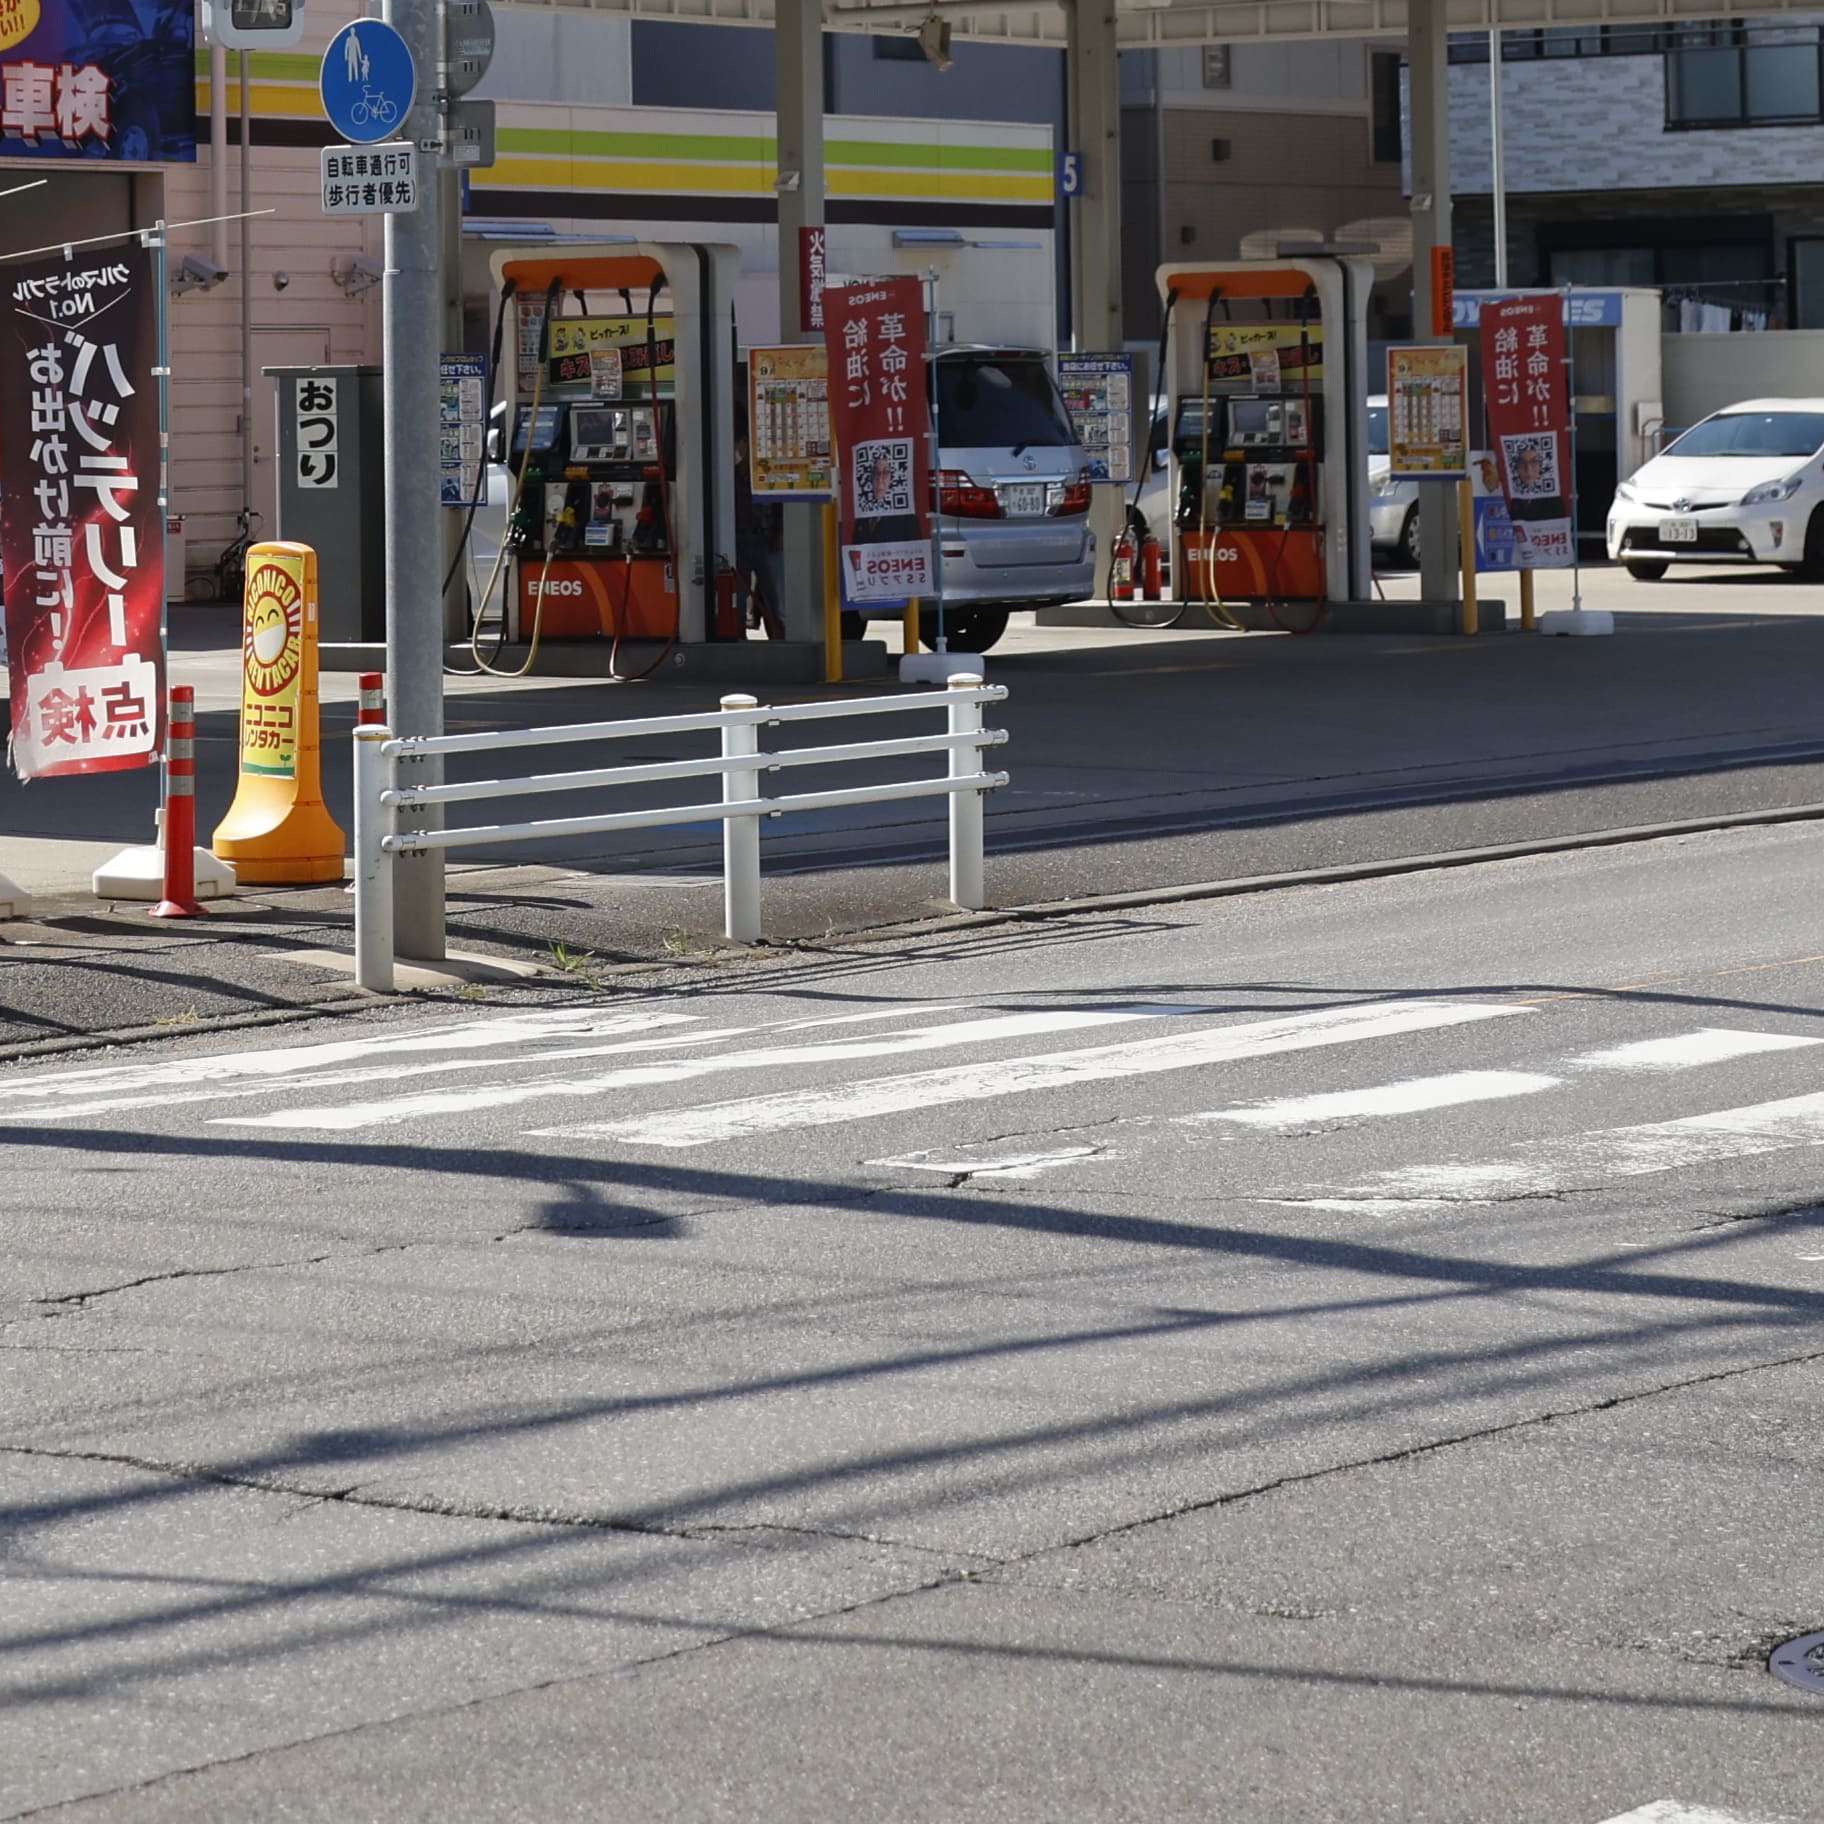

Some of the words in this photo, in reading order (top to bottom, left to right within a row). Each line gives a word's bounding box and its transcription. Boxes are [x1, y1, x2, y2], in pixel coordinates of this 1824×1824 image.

[2, 58, 111, 139] 車検
[326, 150, 412, 179] 自転車通行可
[1063, 157, 1077, 190] 5
[323, 179, 417, 209] (歩行者優先)
[297, 379, 337, 487] おつり
[247, 569, 297, 623] NICONICO
[527, 580, 582, 597] ENEOS
[247, 635, 302, 692] RENTACAR
[245, 703, 294, 729] ニコニコ
[245, 730, 294, 750] レンタカー
